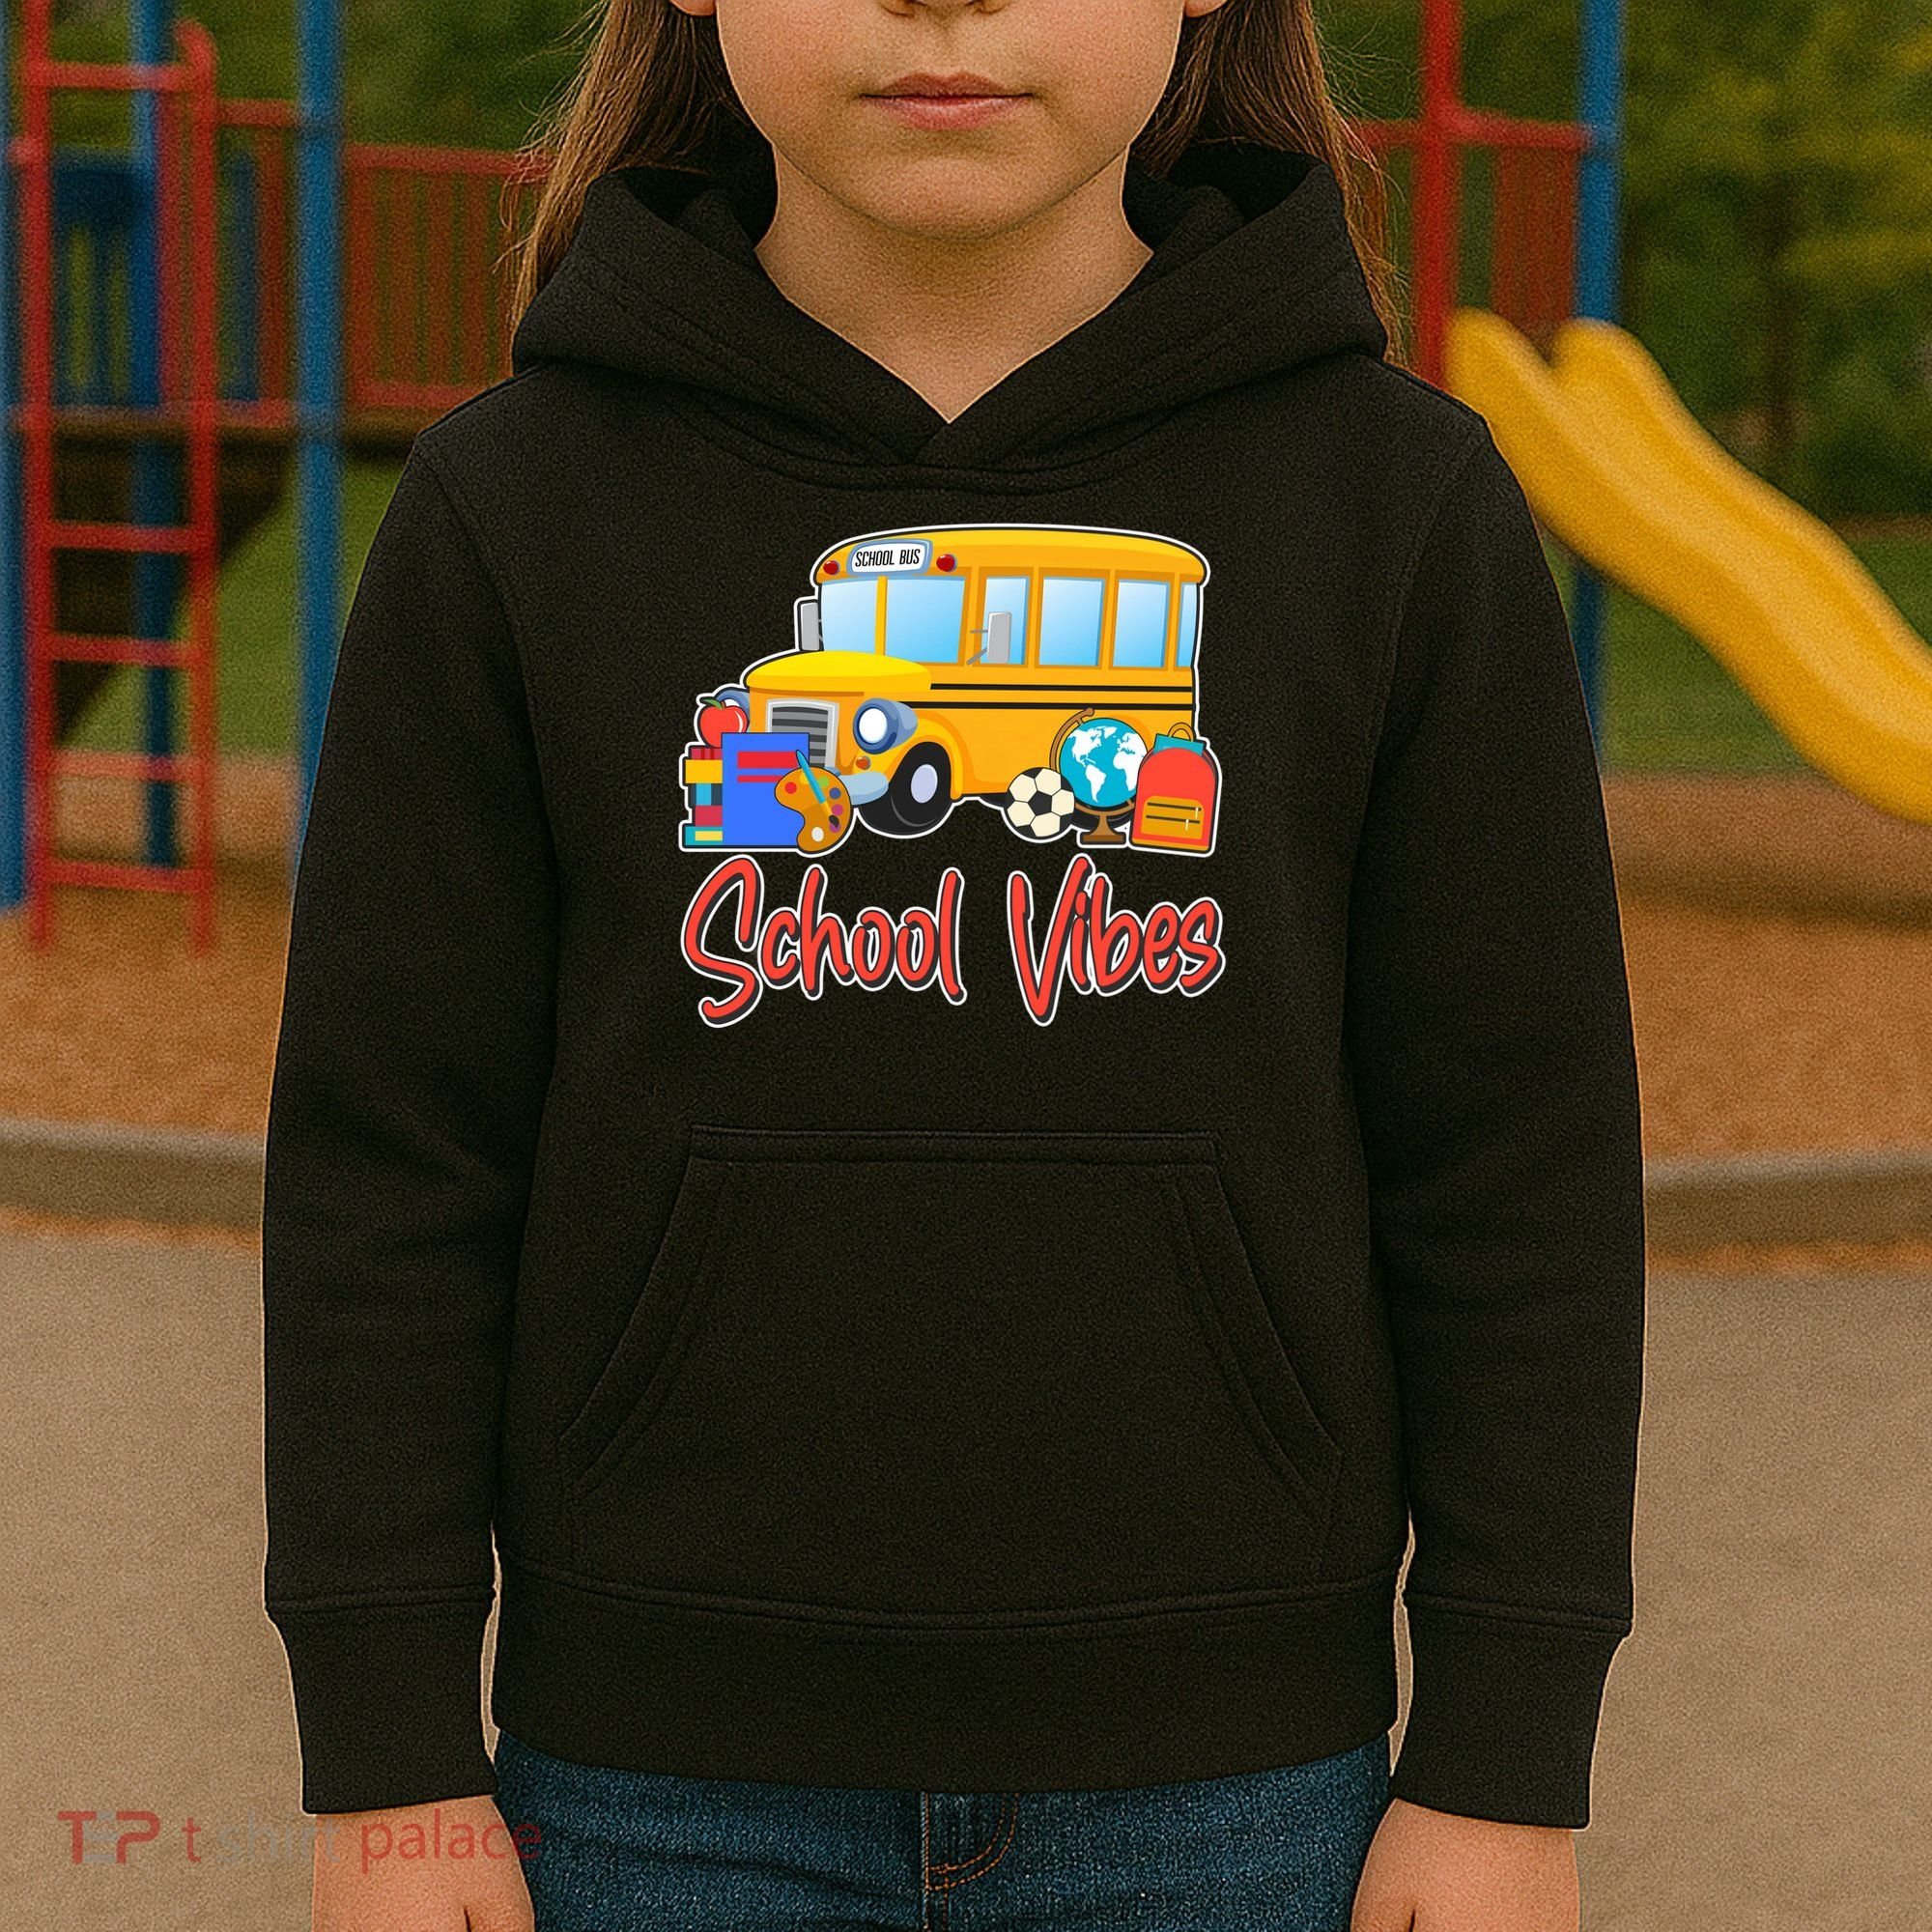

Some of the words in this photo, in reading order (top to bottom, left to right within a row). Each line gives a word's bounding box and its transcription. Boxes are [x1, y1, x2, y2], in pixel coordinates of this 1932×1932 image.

[855, 550, 895, 567] SCHOOL
[899, 549, 921, 565] BUS
[681, 855, 967, 1028] School
[1008, 854, 1226, 1026] Vibes
